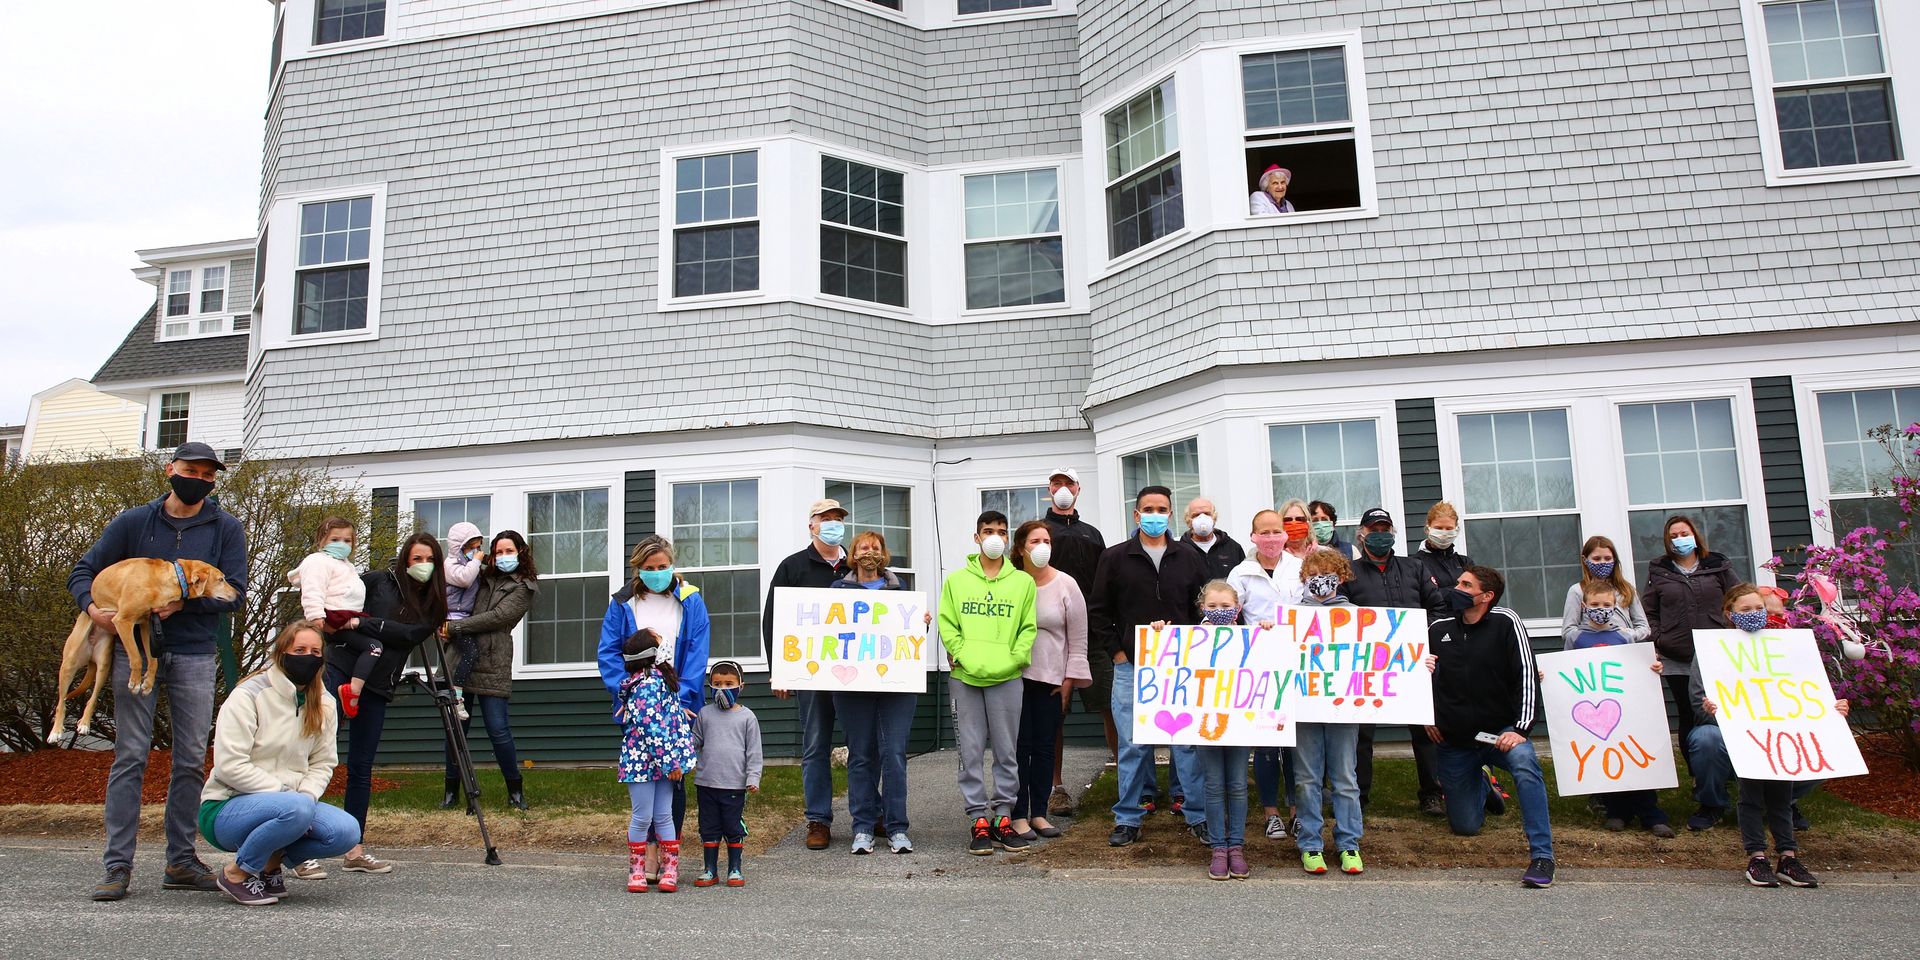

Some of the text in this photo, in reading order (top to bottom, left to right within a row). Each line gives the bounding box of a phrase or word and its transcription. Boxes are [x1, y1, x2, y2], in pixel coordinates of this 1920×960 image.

[796, 600, 918, 630] HAPPY
[961, 601, 1015, 618] BECKET
[783, 632, 926, 662] BIRTHDAY
[1138, 625, 1263, 668] HAPPY
[1299, 641, 1425, 672] iRTHDAY
[1718, 636, 1792, 677] WE
[1345, 671, 1398, 697] NEE
[1558, 661, 1624, 694] WE
[1715, 677, 1827, 721] MISS
[1198, 712, 1230, 741] U
[1570, 735, 1656, 783] YOU
[1746, 728, 1835, 776] YOU
